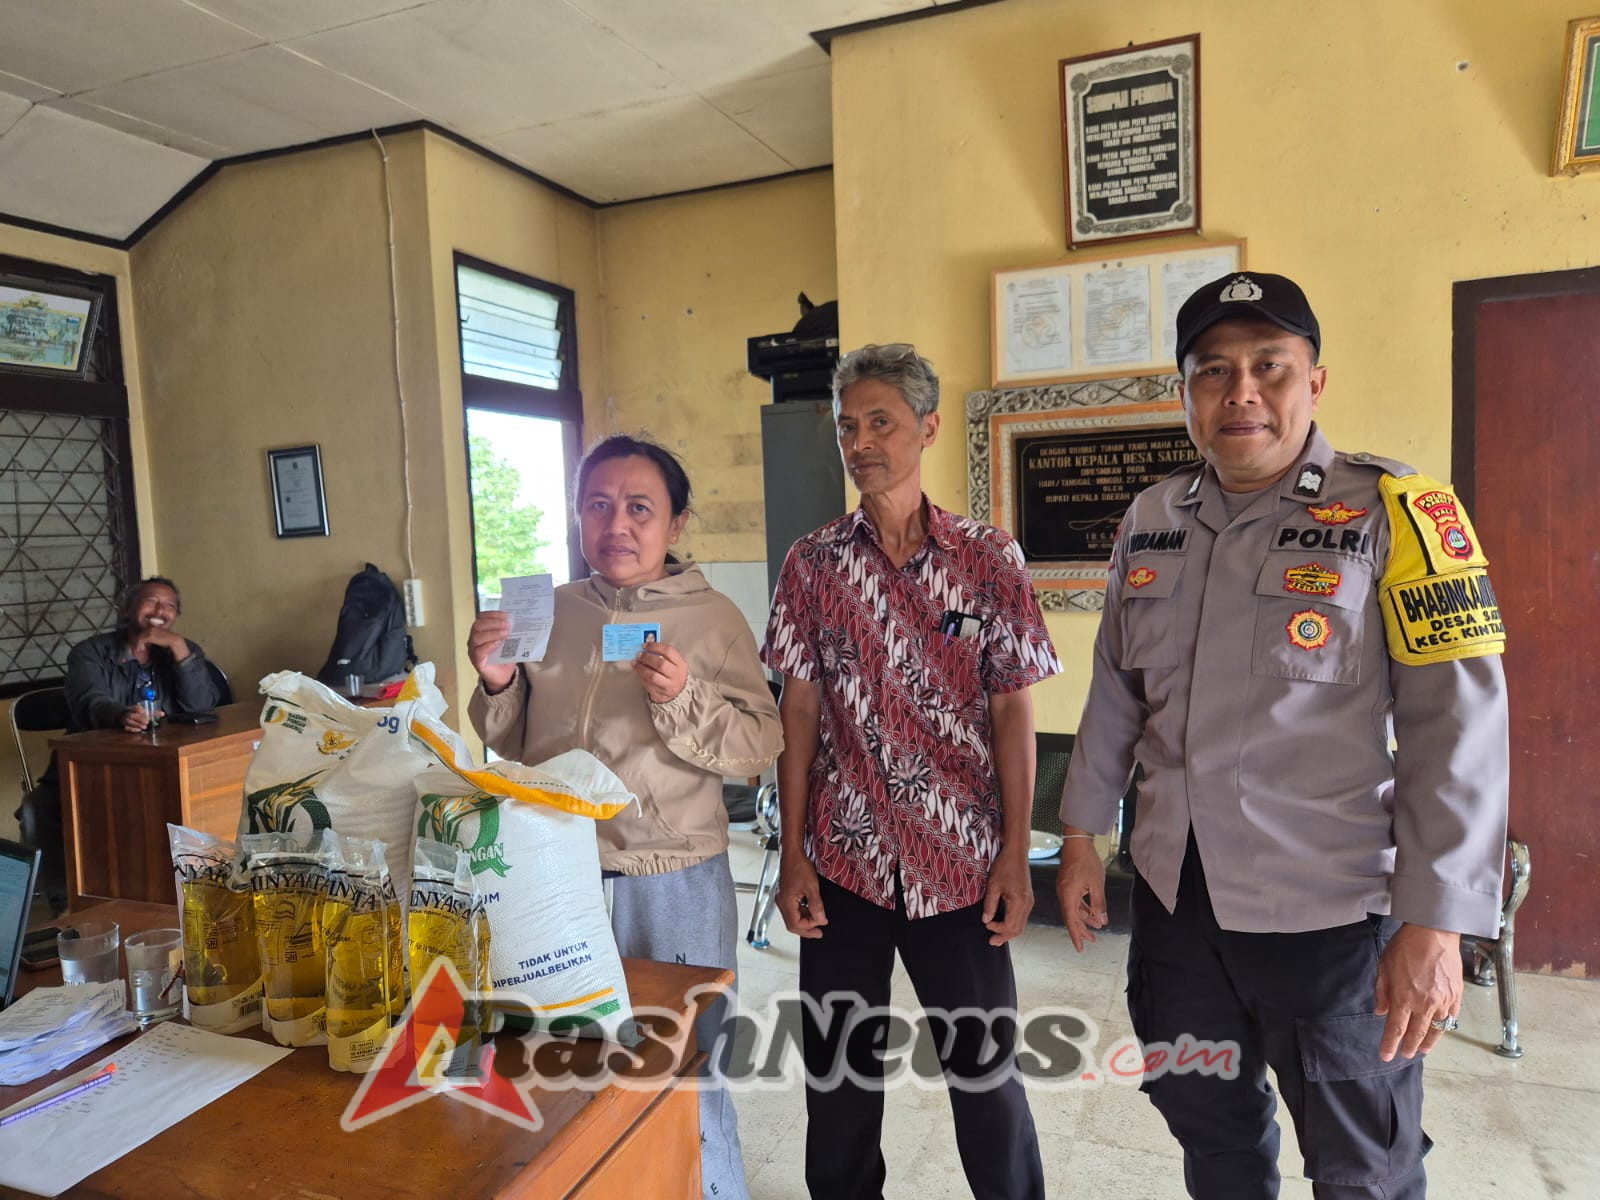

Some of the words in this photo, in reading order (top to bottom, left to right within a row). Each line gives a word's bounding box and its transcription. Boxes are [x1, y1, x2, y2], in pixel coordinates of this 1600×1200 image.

[1029, 456, 1071, 470] KANTOR
[1075, 454, 1118, 466] KEPALA
[1123, 452, 1154, 464] DESA
[1278, 528, 1370, 554] POLRI
[1430, 614, 1476, 632] DESA
[1414, 631, 1459, 649] KEC.
[518, 952, 551, 971] TIDAK
[553, 940, 590, 959] UNTUK
